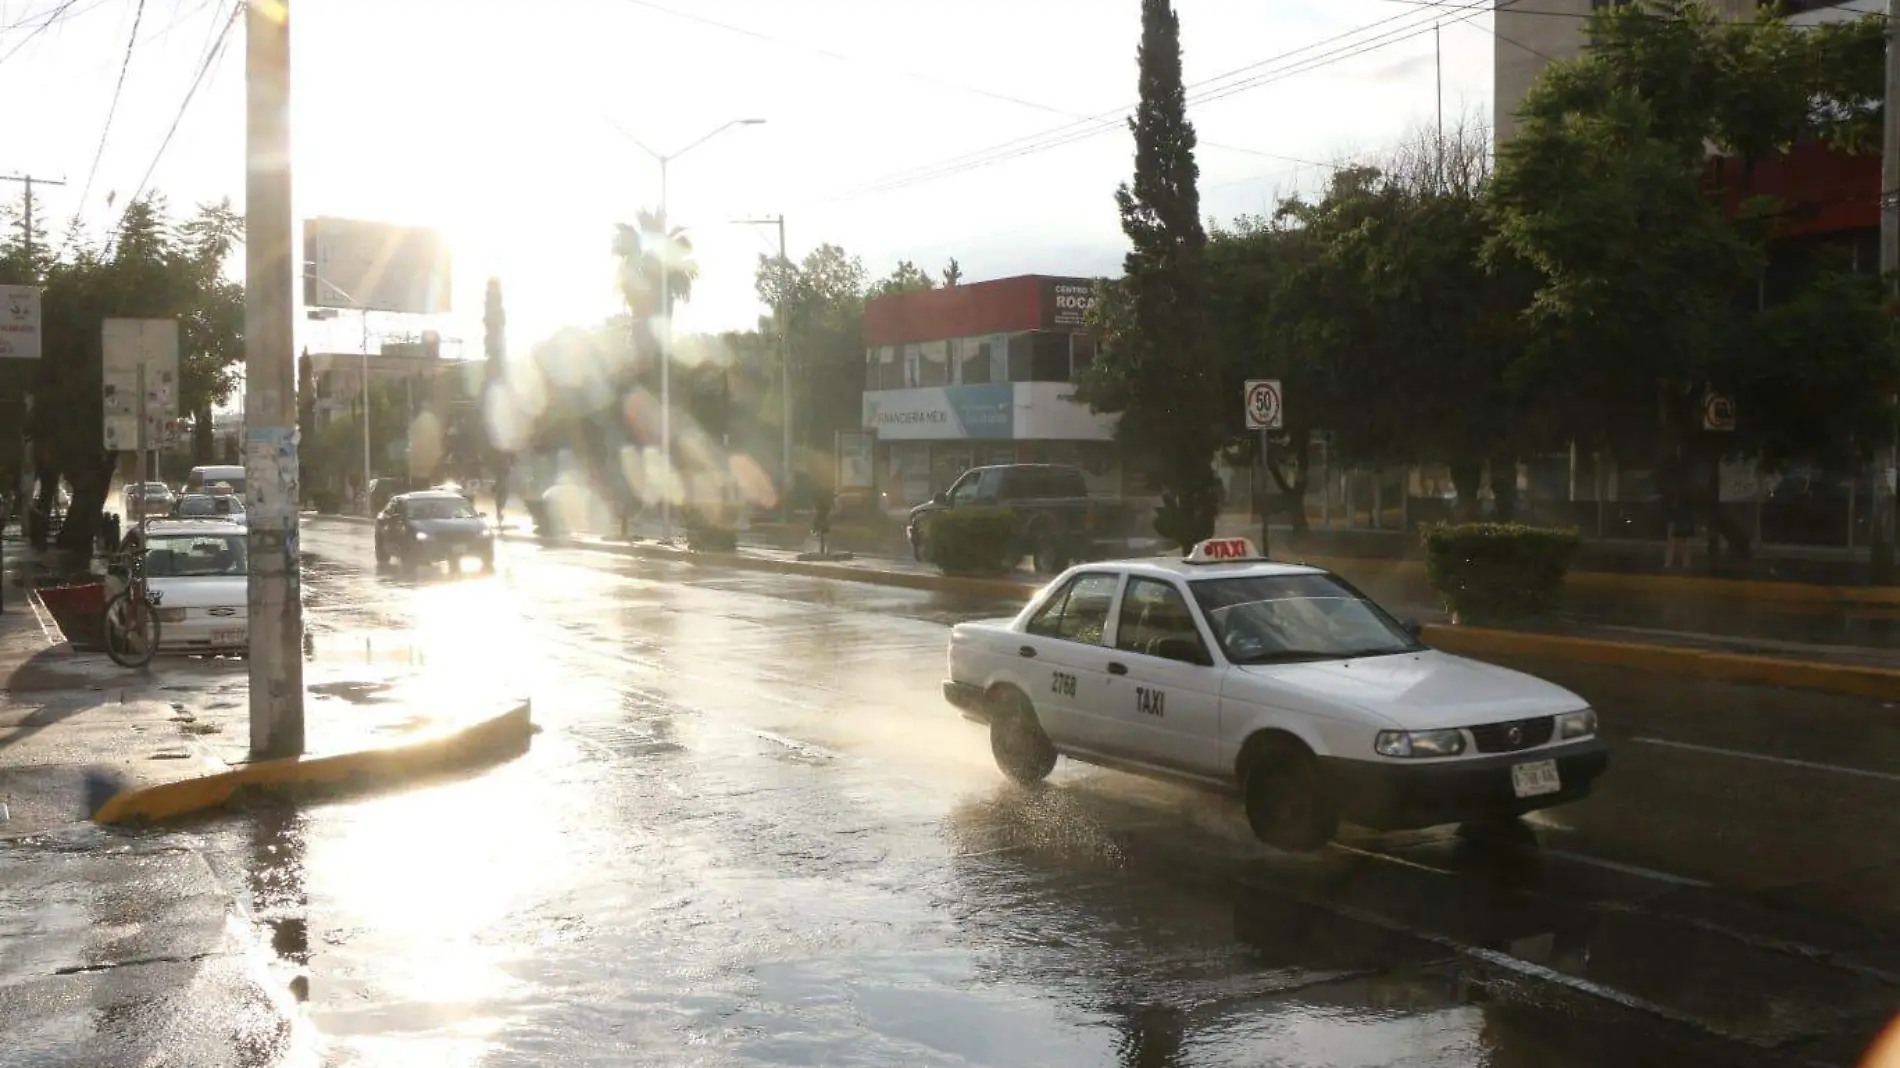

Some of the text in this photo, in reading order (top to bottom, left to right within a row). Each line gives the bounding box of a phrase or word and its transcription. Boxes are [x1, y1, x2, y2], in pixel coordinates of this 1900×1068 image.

[1055, 285, 1088, 294] CENTRO
[1256, 391, 1272, 412] 50
[1208, 539, 1246, 558] TAXI
[1136, 686, 1165, 718] TAXI
